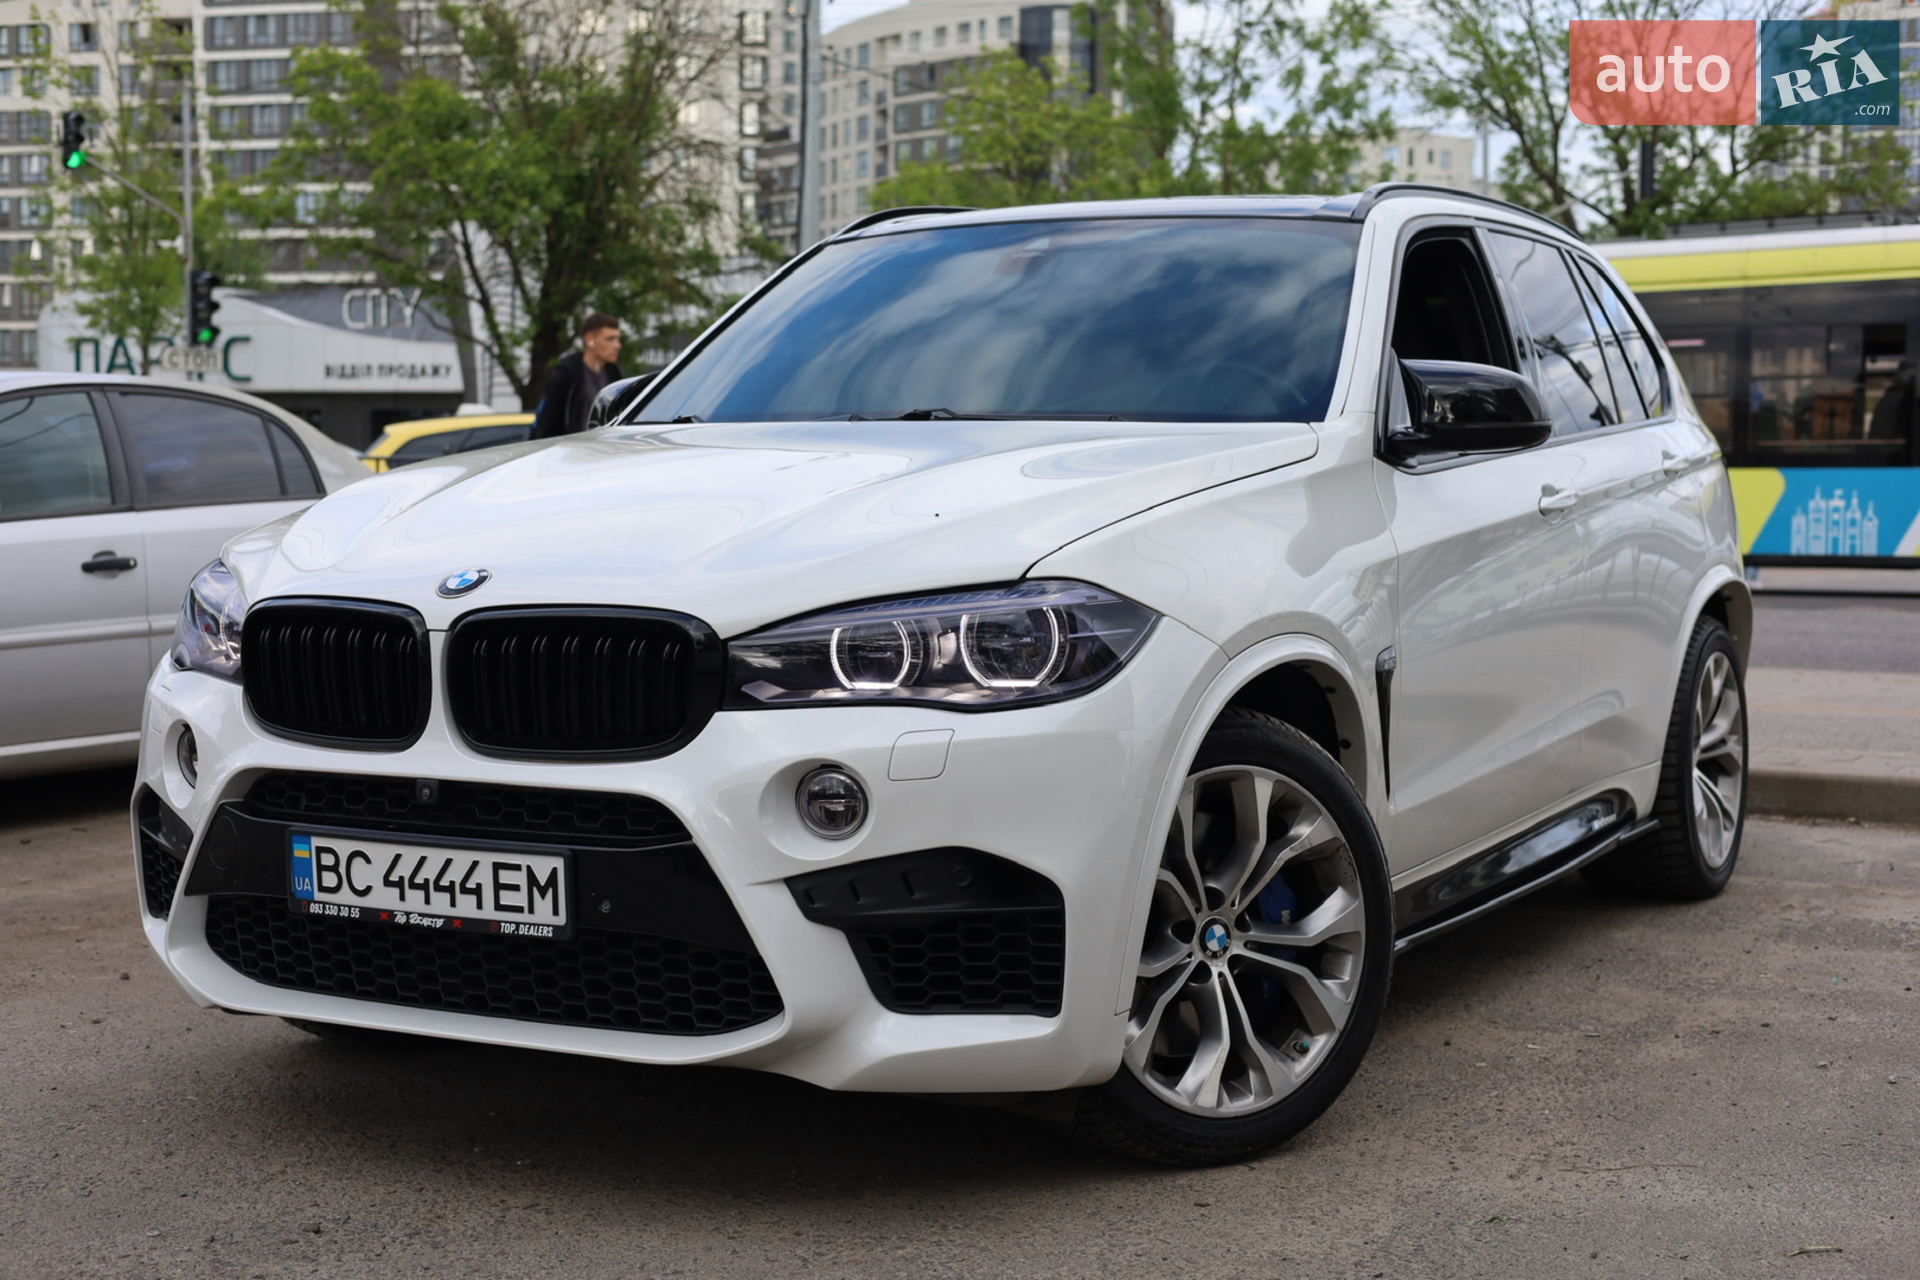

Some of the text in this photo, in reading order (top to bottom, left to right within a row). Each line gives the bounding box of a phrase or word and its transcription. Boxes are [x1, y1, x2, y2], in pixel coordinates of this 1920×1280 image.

[341, 287, 423, 330] CITY
[324, 363, 453, 380] ВІДДІЛ ПРОДАЖУ
[295, 876, 312, 893] UA
[309, 902, 360, 919] 093 330 30 55
